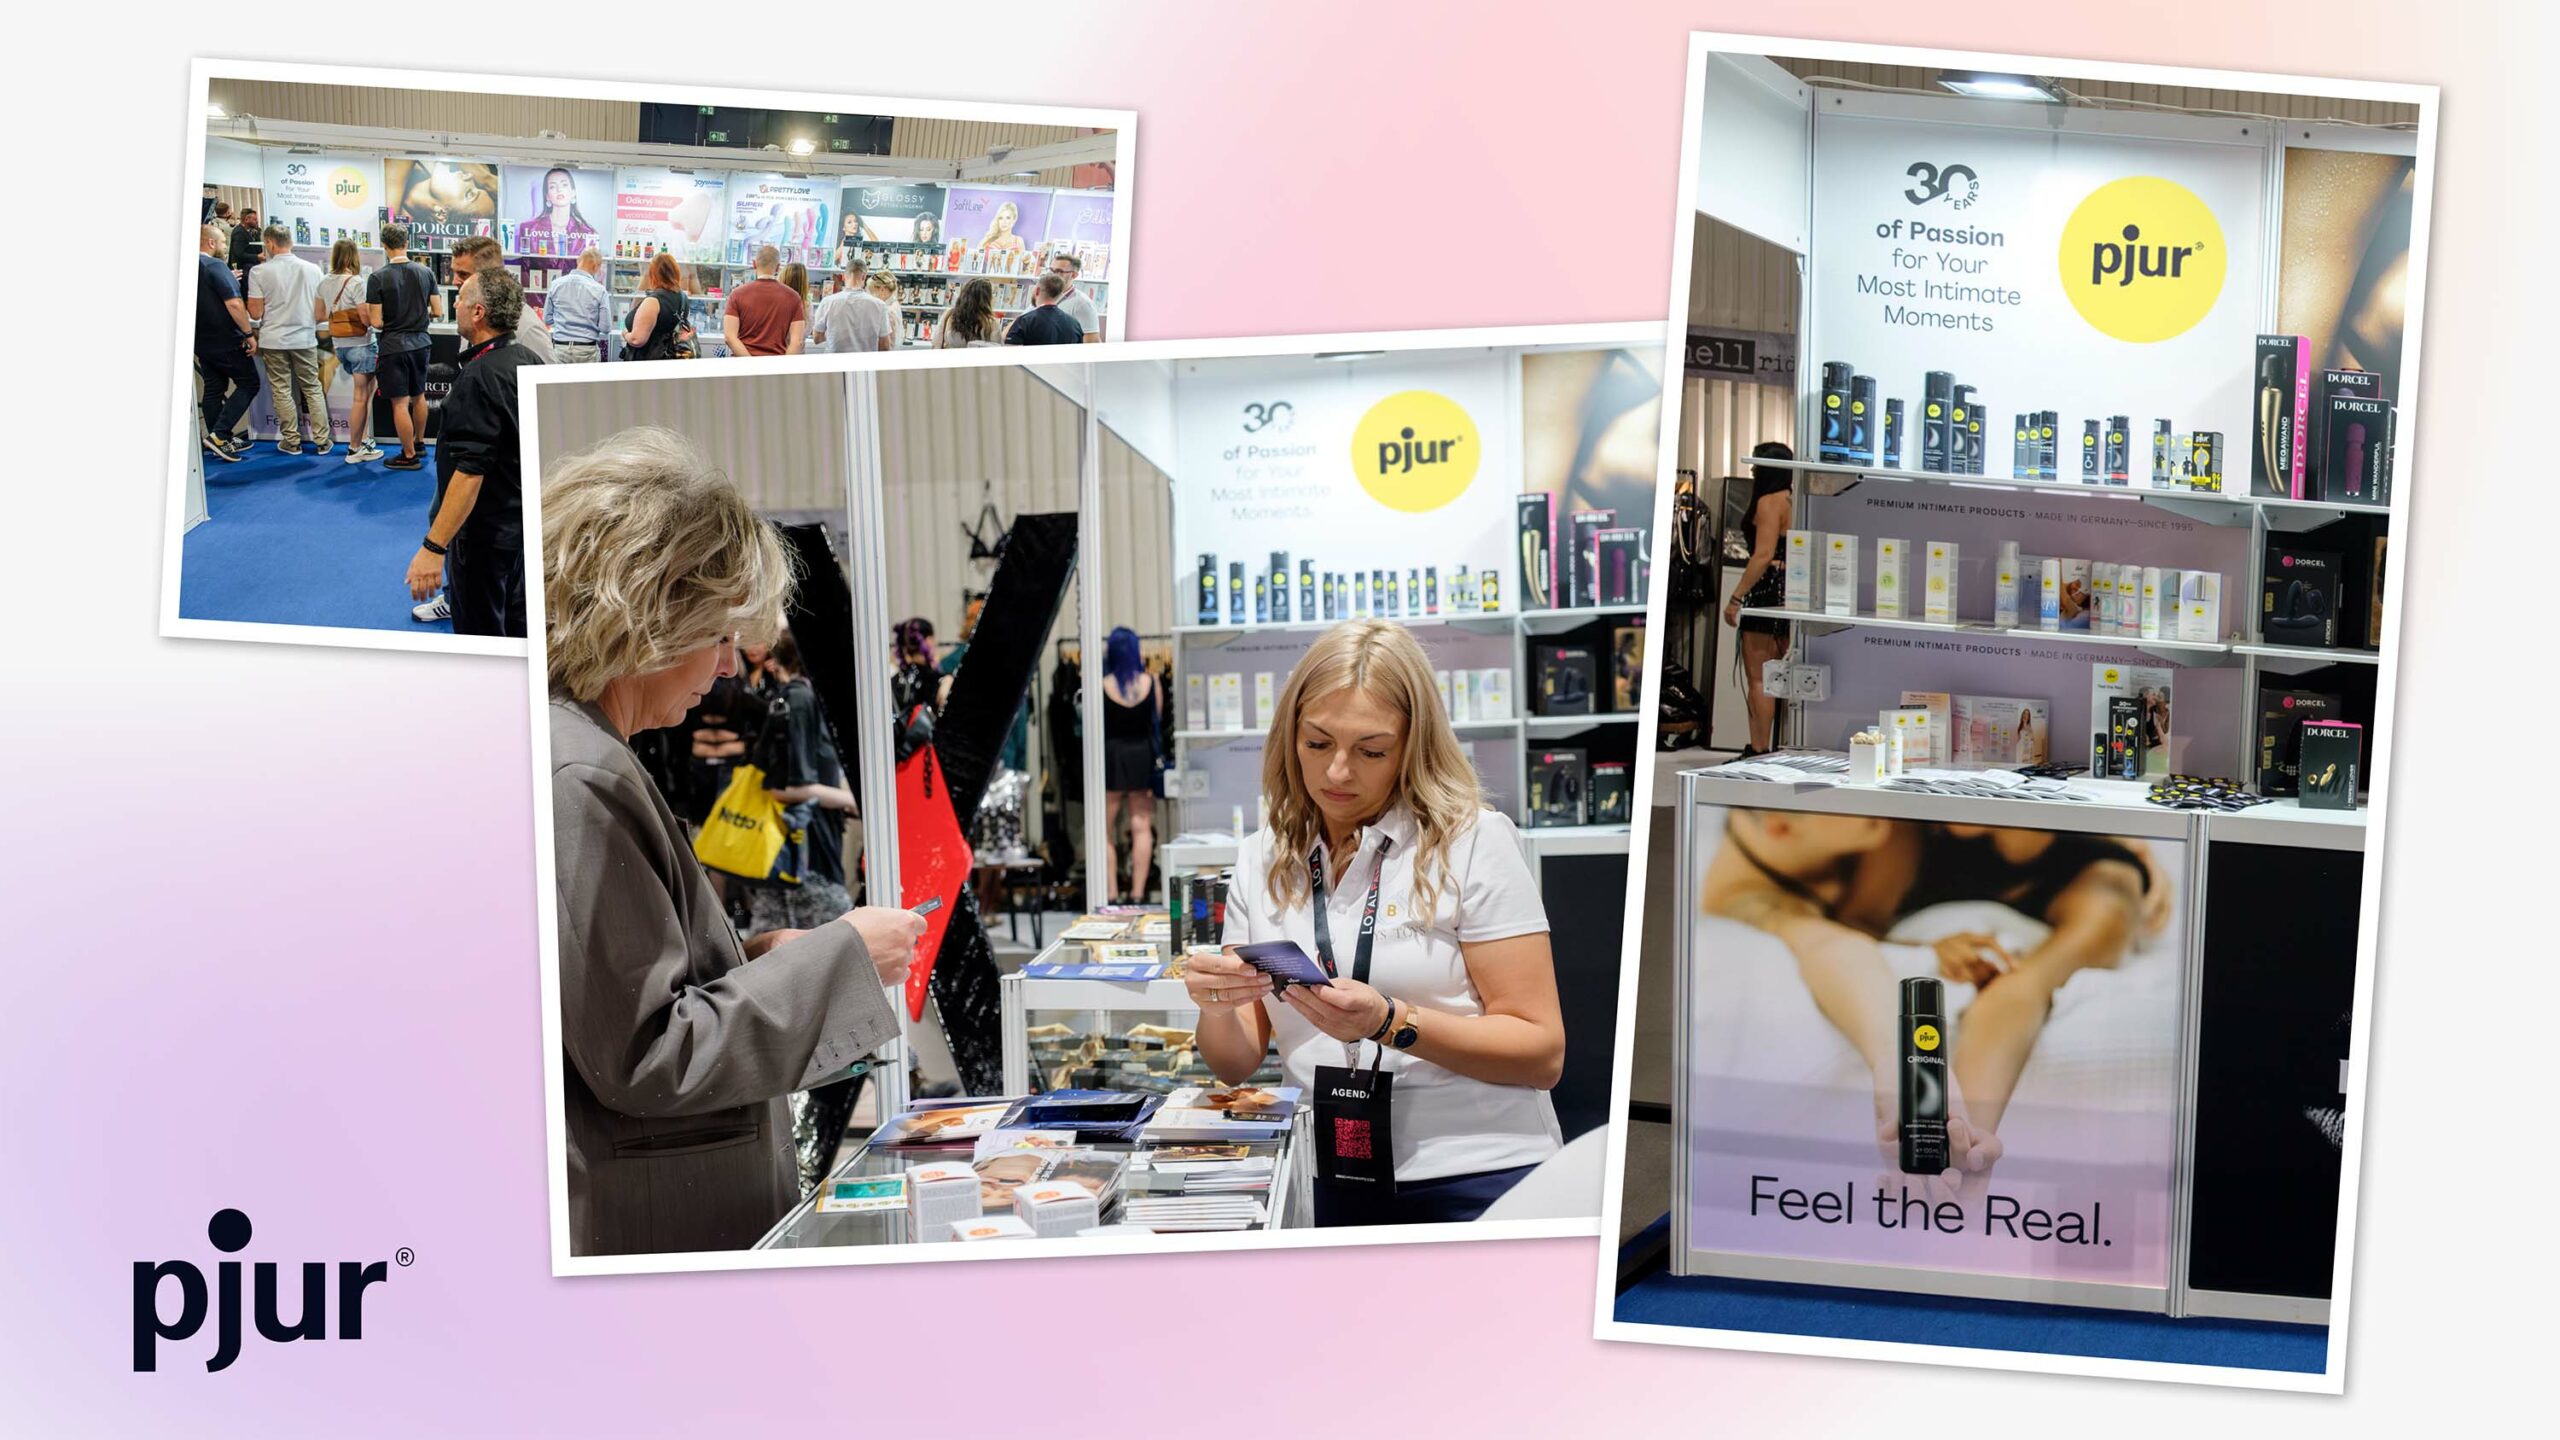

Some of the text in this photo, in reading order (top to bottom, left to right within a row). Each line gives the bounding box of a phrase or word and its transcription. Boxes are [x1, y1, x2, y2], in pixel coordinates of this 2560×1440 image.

[289, 178, 315, 186] Passion
[335, 179, 361, 196] pjur
[881, 192, 925, 202] GLOSSY
[1943, 180, 1979, 210] YEARS
[524, 228, 550, 238] Love
[1876, 219, 2004, 247] of Passion
[1892, 247, 1989, 274] for Your
[1857, 274, 2021, 306] Most Intimate
[1884, 304, 1994, 332] Moments
[2258, 338, 2291, 347] DORCEL
[1758, 354, 1795, 373] rid
[2327, 373, 2371, 386] DORCEL
[2334, 400, 2382, 414] DORCEL
[1243, 401, 1294, 433] 30
[2296, 371, 2308, 468] DORCEL
[2279, 416, 2288, 470] MEGAWAND
[1223, 444, 1317, 461] of Passion
[1211, 483, 1331, 502] Most Intimate
[1231, 505, 1312, 521] Moments
[1866, 498, 1914, 510] PREMIUM
[1918, 502, 1966, 514] INTIMATE
[1969, 506, 2026, 519] PRODUCTS
[2034, 511, 2063, 521] MADE
[2066, 514, 2077, 522] IN
[2171, 522, 2194, 532] 1995
[2295, 558, 2326, 568] DORCEL
[1864, 636, 1911, 648] PREMIUM
[1914, 640, 1962, 652] INTIMATE
[1965, 644, 2021, 656] PRODUCTS
[2031, 650, 2059, 660] MADE
[2062, 651, 2073, 661] IN
[2296, 699, 2326, 707] DORCEL
[2307, 727, 2349, 739] DORCEL
[1387, 905, 1397, 917] B
[1919, 1031, 1936, 1042] pjur
[1907, 1055, 1946, 1066] ORIGINAL
[1751, 1175, 2112, 1247] Feel the Real.
